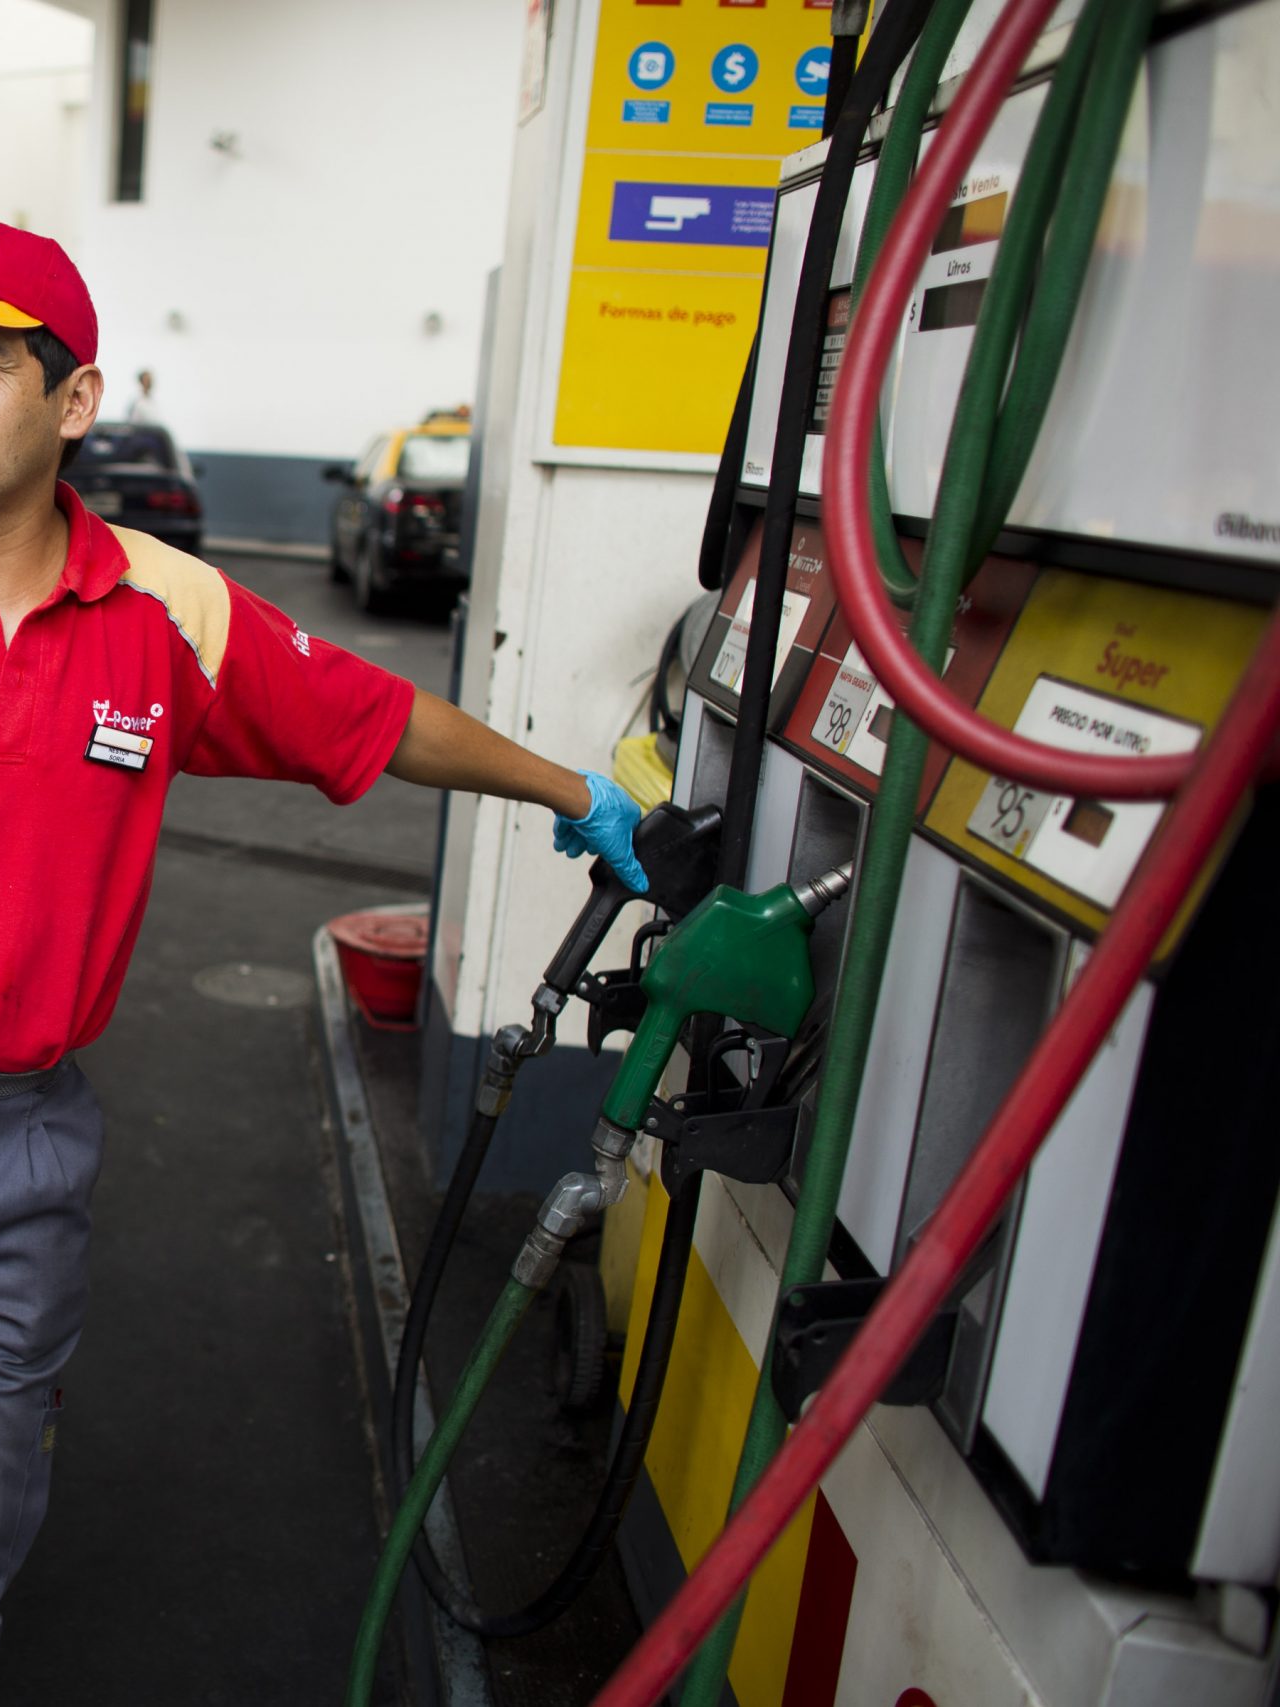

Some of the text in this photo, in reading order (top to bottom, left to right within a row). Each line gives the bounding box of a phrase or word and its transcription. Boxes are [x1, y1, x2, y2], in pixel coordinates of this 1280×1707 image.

[972, 174, 1000, 194] Venta
[947, 260, 972, 277] Litros
[599, 302, 736, 328] Formas de pago
[1096, 641, 1169, 690] Super
[93, 710, 156, 731] V-Power
[825, 704, 852, 745] 98
[1049, 705, 1150, 753] PRECIO POR LITRO
[108, 755, 125, 763] SORIA
[991, 783, 1034, 838] 95
